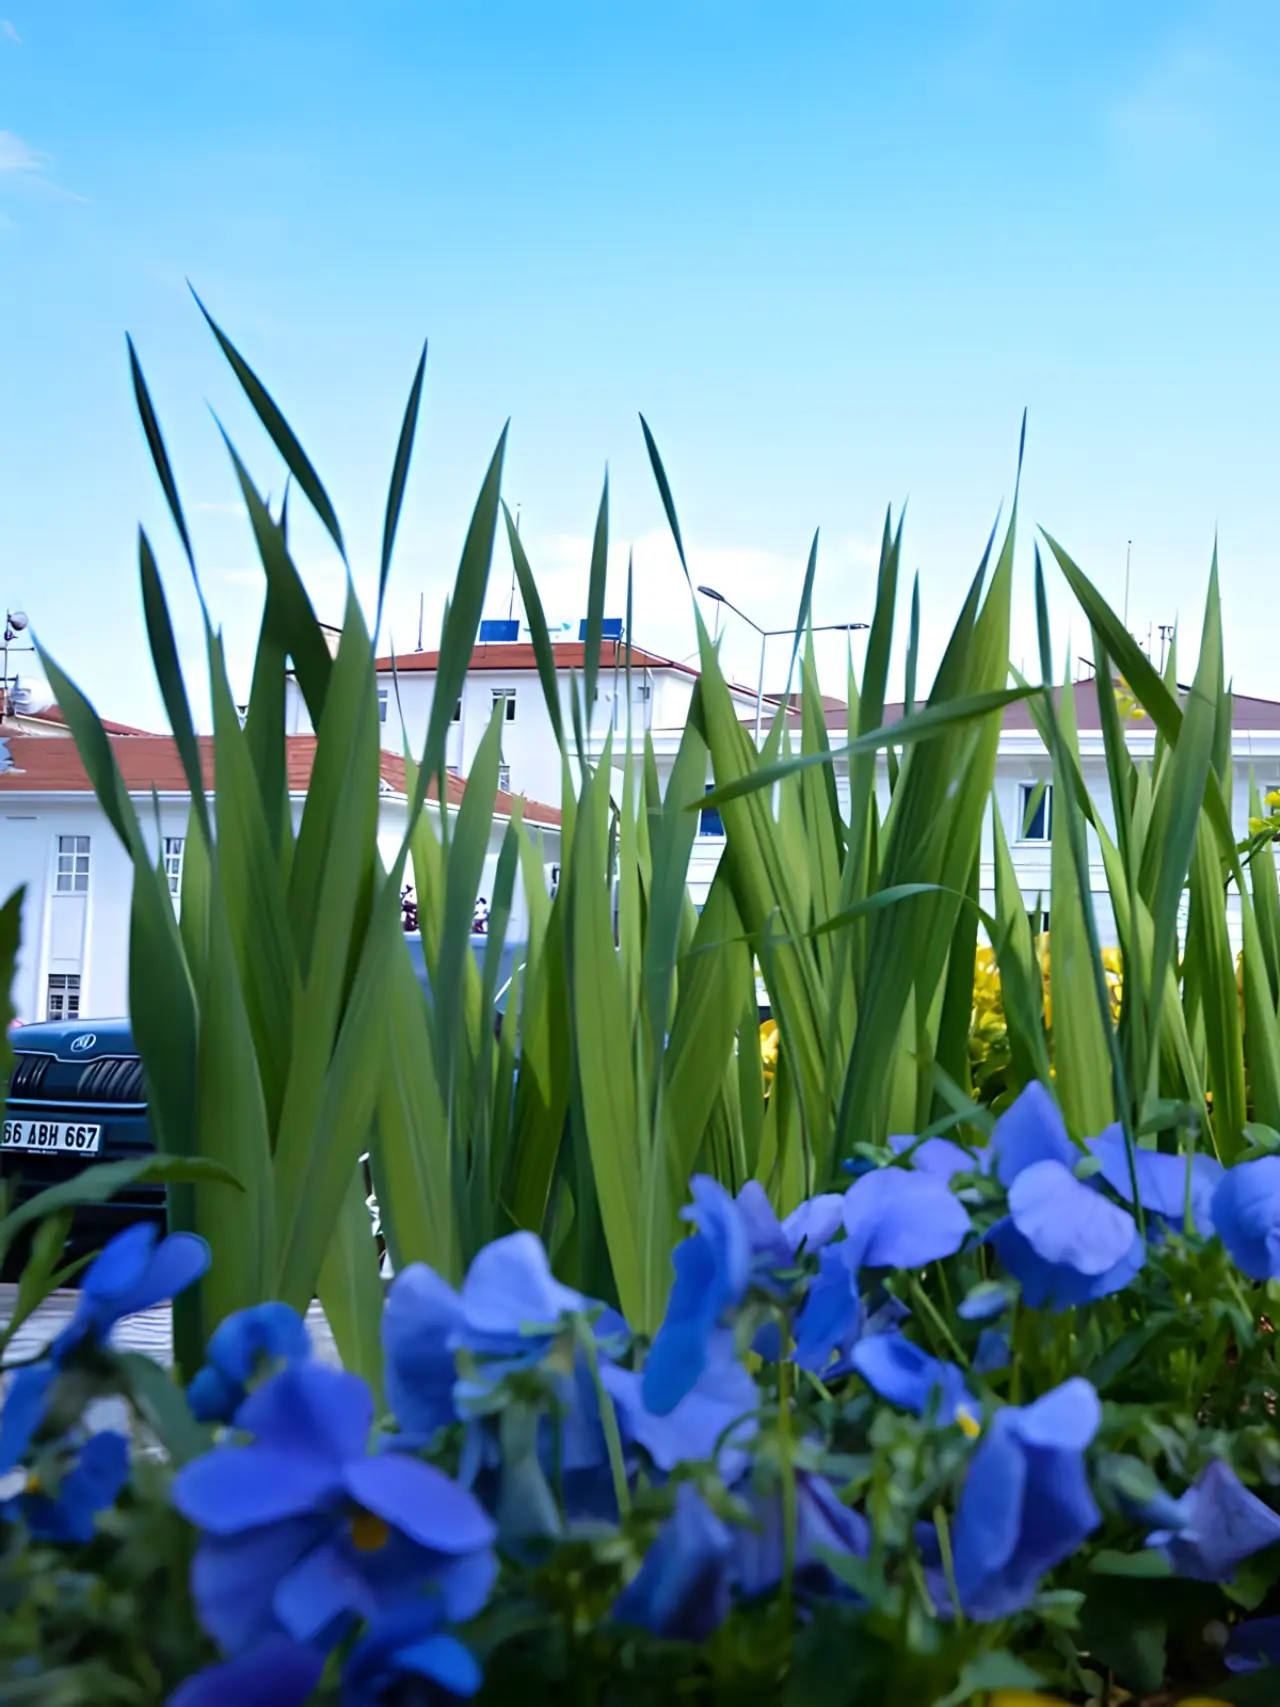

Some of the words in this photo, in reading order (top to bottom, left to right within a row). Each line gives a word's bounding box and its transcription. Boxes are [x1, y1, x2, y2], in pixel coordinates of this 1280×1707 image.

[3, 1122, 22, 1144] 66
[27, 1123, 59, 1146] ABH
[65, 1126, 98, 1149] 667
